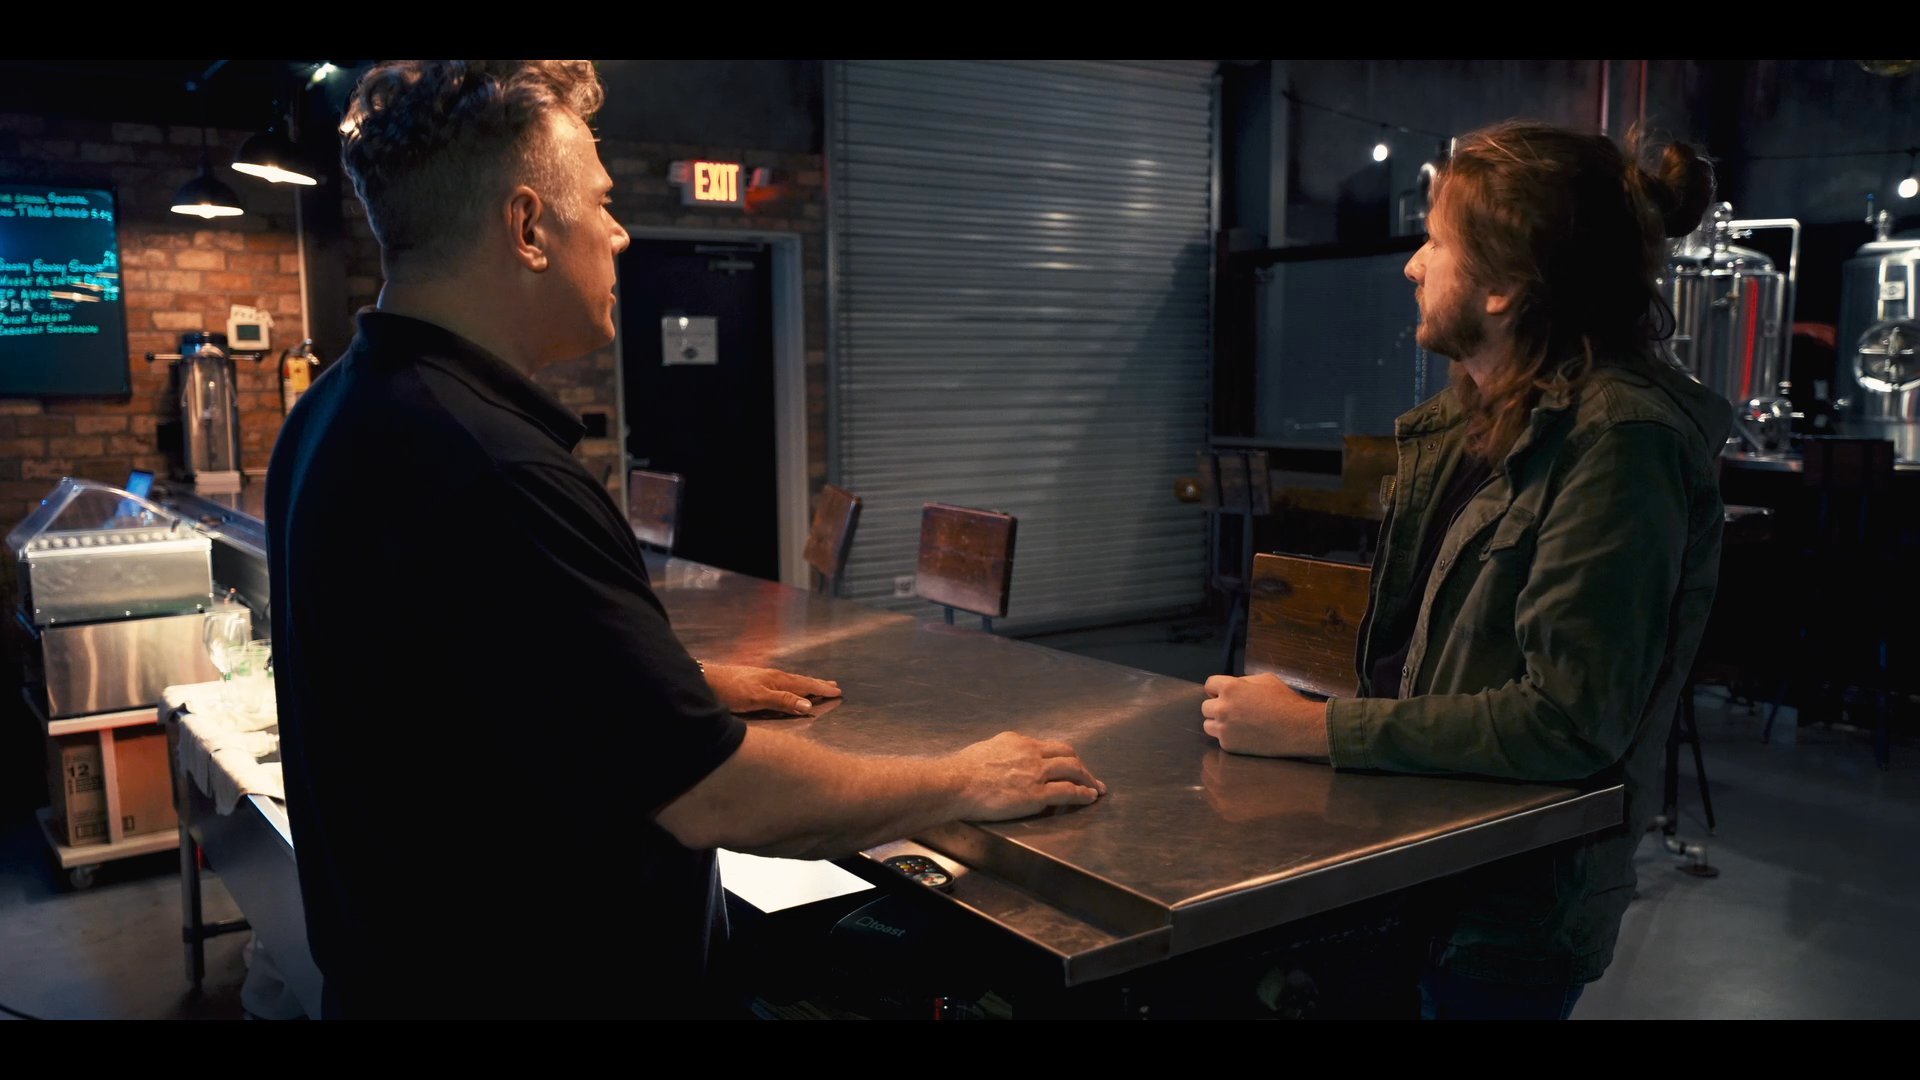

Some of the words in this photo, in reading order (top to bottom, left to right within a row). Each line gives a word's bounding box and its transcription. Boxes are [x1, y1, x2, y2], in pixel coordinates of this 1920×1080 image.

[694, 161, 739, 202] EXIT
[67, 763, 89, 777] 12
[870, 921, 906, 937] toast
